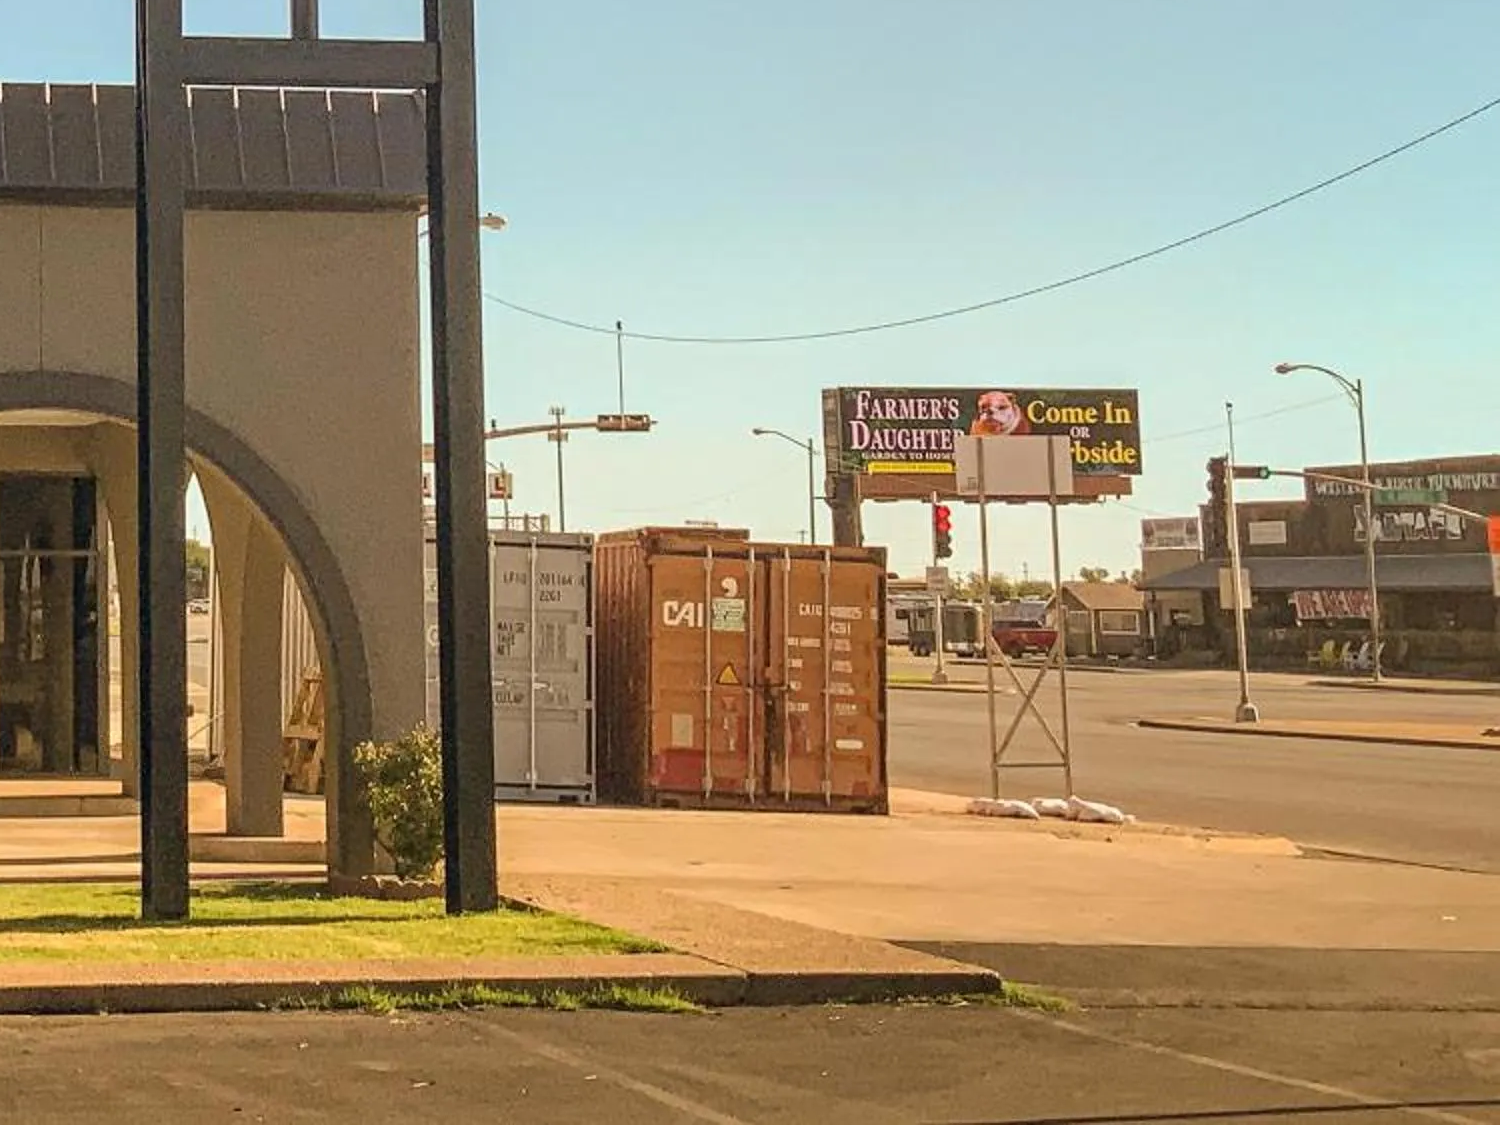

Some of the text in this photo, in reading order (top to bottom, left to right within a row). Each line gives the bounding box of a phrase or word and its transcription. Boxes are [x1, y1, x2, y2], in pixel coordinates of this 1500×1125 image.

[856, 390, 960, 420] FARMER'S
[1027, 400, 1132, 424] Come In
[1070, 426, 1091, 438] OR
[925, 451, 954, 460] HOM
[663, 600, 704, 628] CAI
